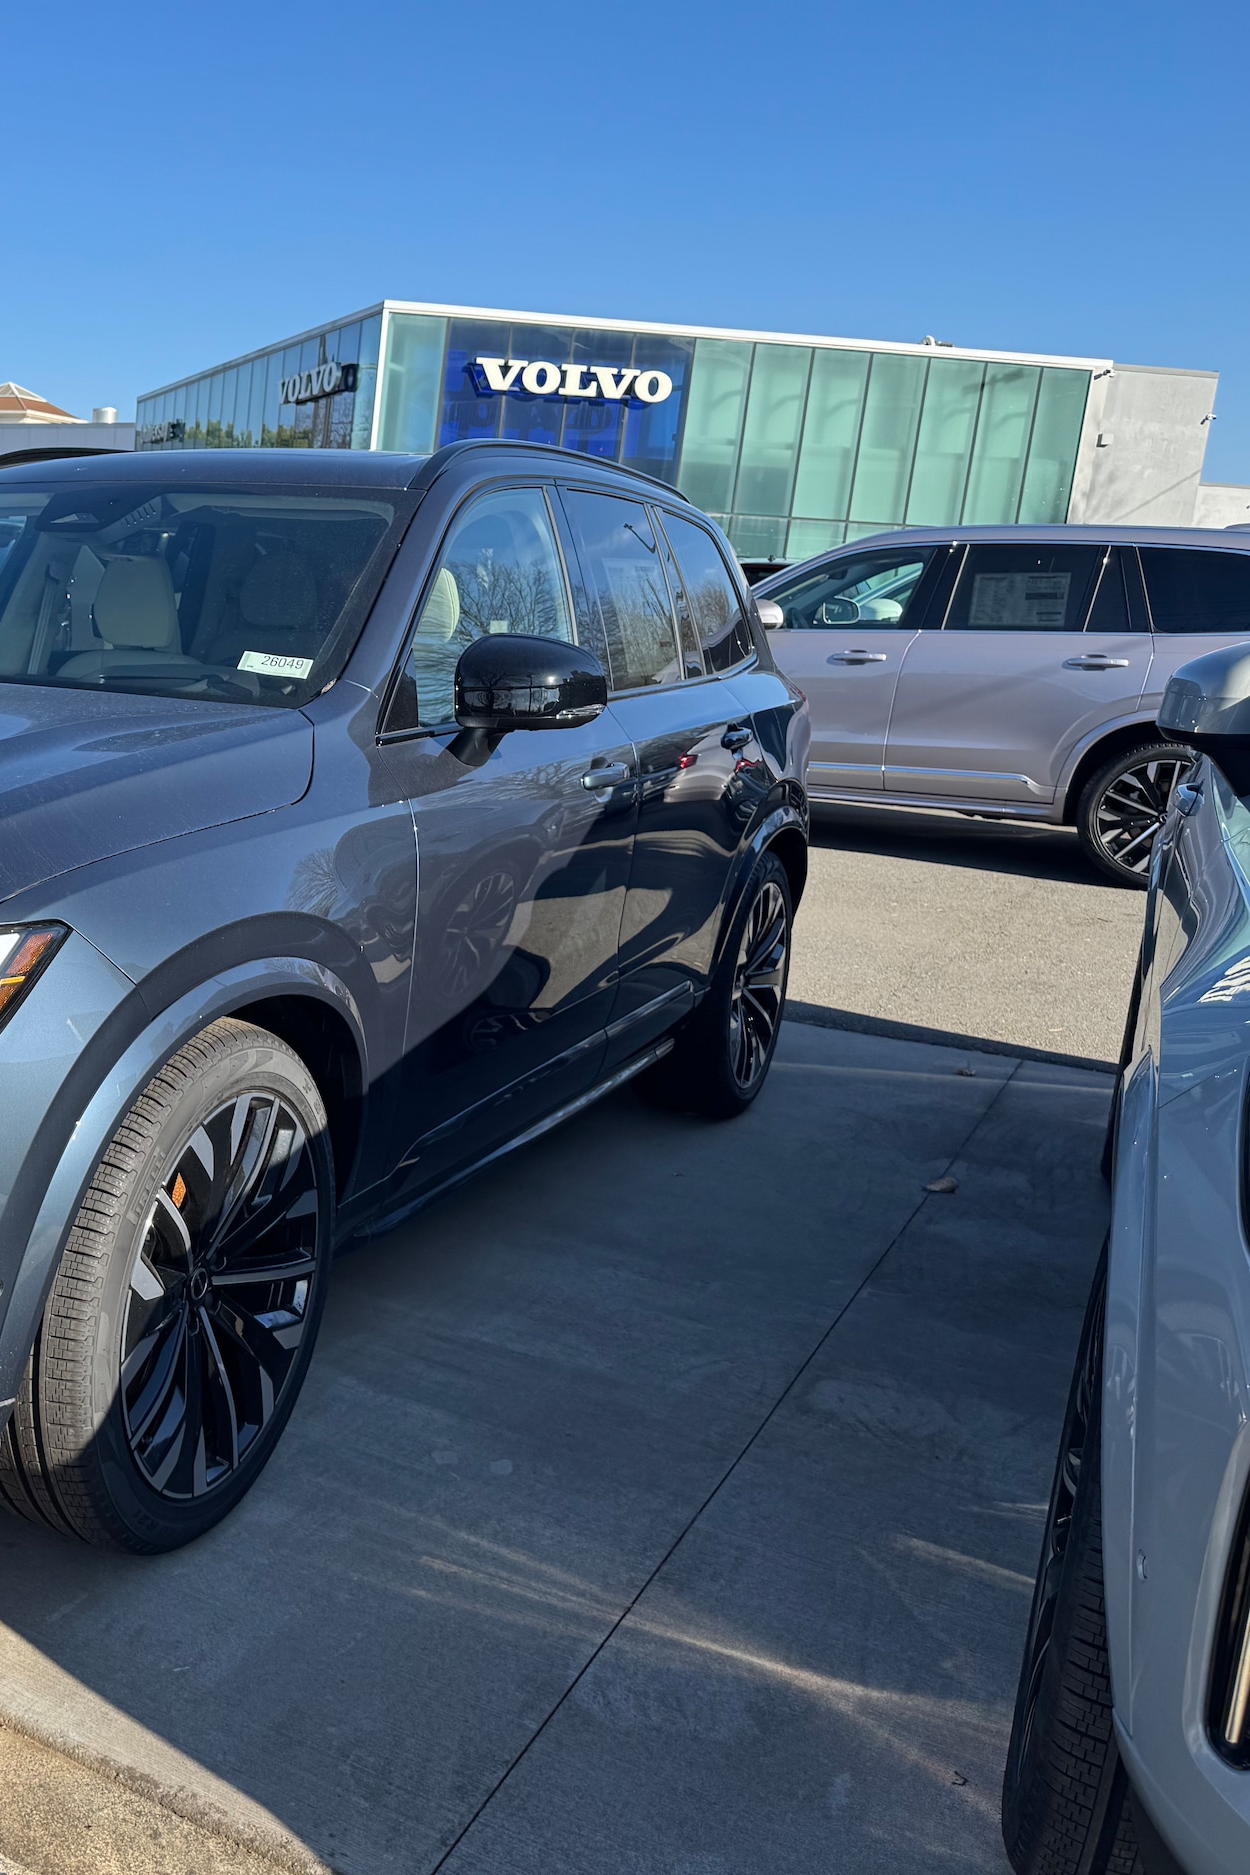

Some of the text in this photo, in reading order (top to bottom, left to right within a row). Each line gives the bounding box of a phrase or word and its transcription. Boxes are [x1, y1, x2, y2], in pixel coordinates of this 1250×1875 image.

[279, 361, 341, 405] VOLVO
[475, 356, 673, 403] VOLVO
[261, 655, 305, 670] 26049
